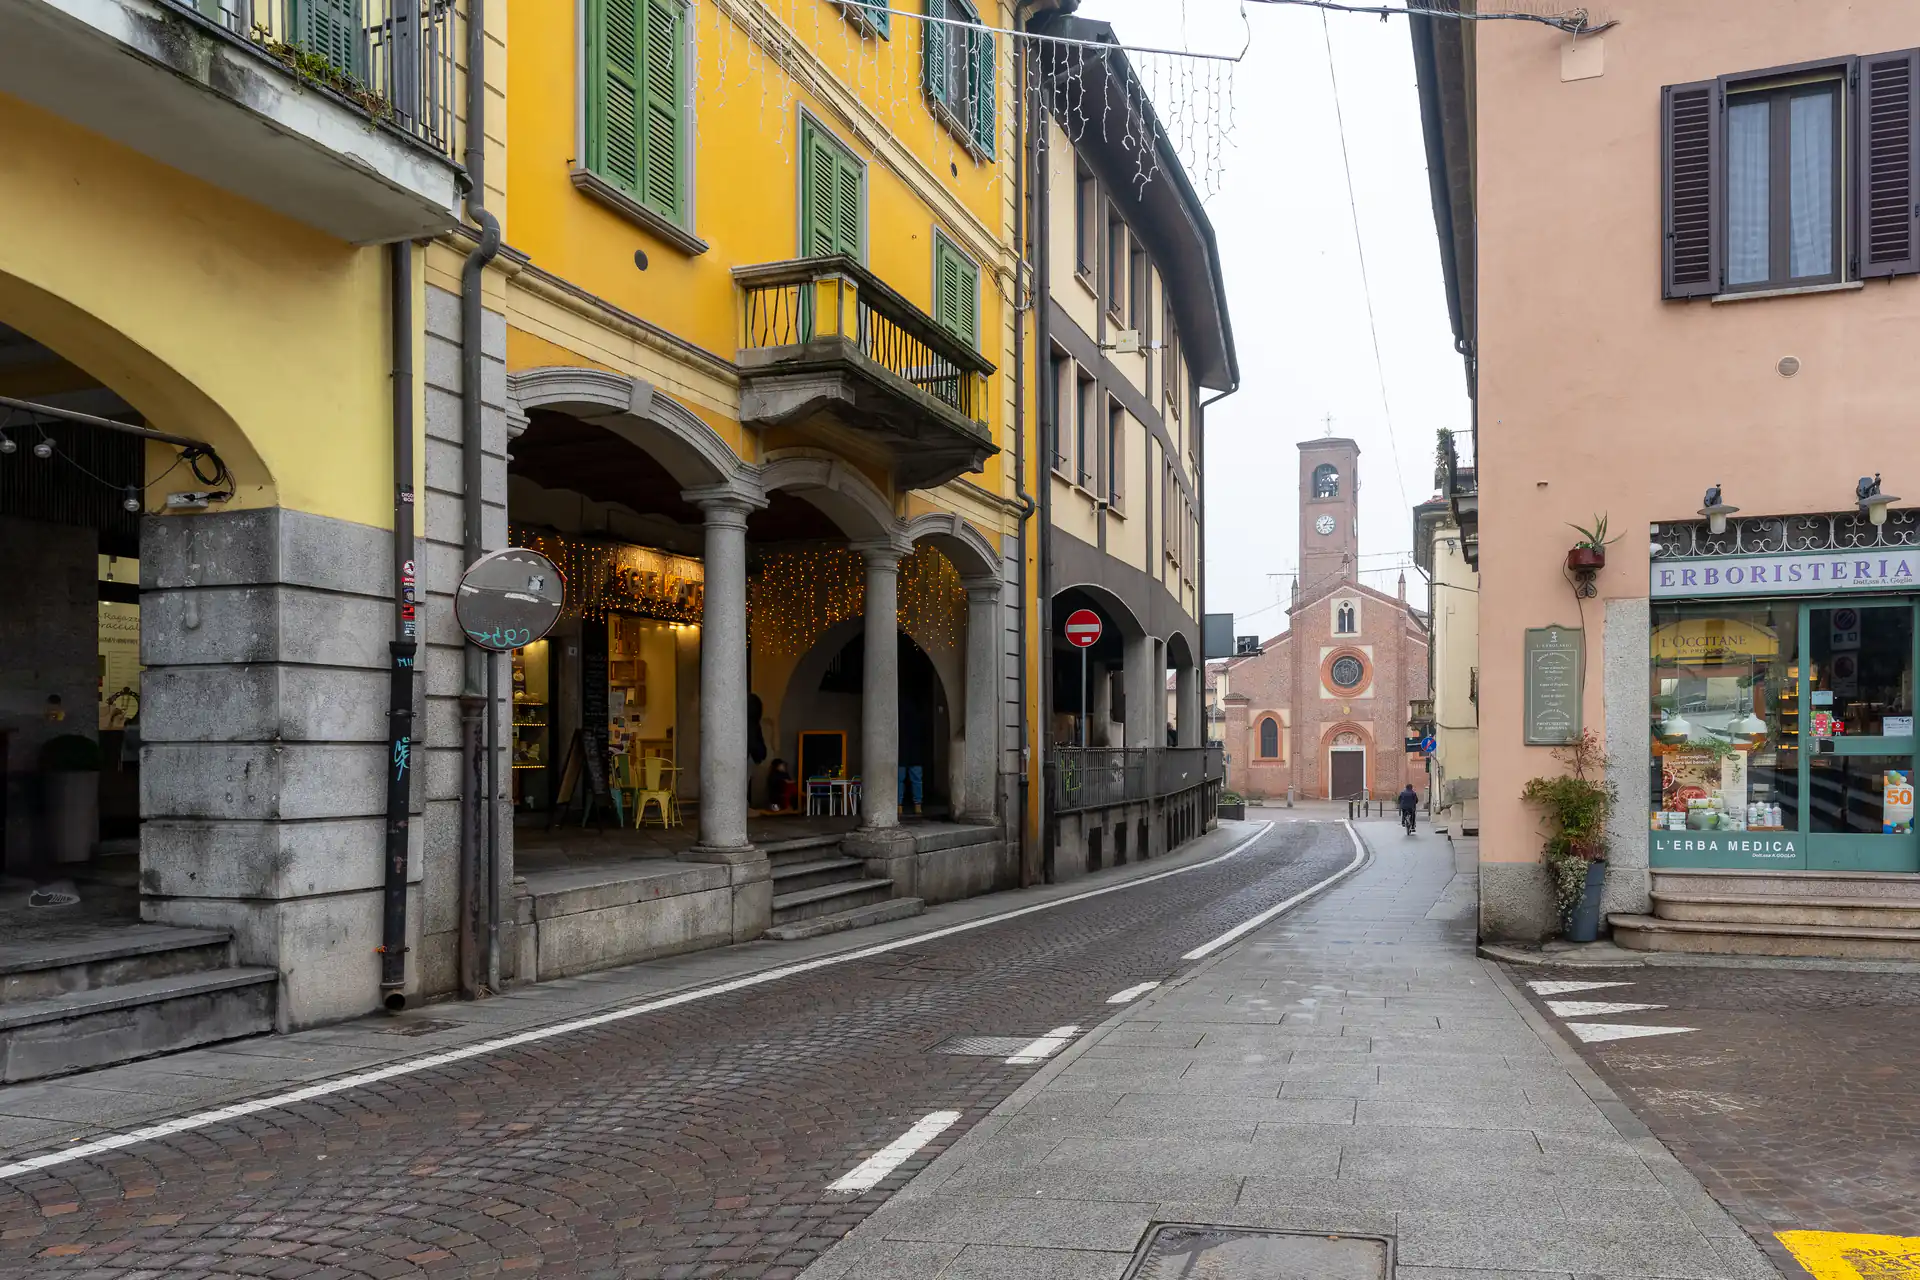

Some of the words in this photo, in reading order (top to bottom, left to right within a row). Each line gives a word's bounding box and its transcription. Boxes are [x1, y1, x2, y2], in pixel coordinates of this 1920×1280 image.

[1660, 559, 1913, 587] ERBORISTERIA
[1887, 789, 1912, 805] 50
[1656, 840, 1719, 851] L'ERBA
[1728, 841, 1795, 852] MEDICA
